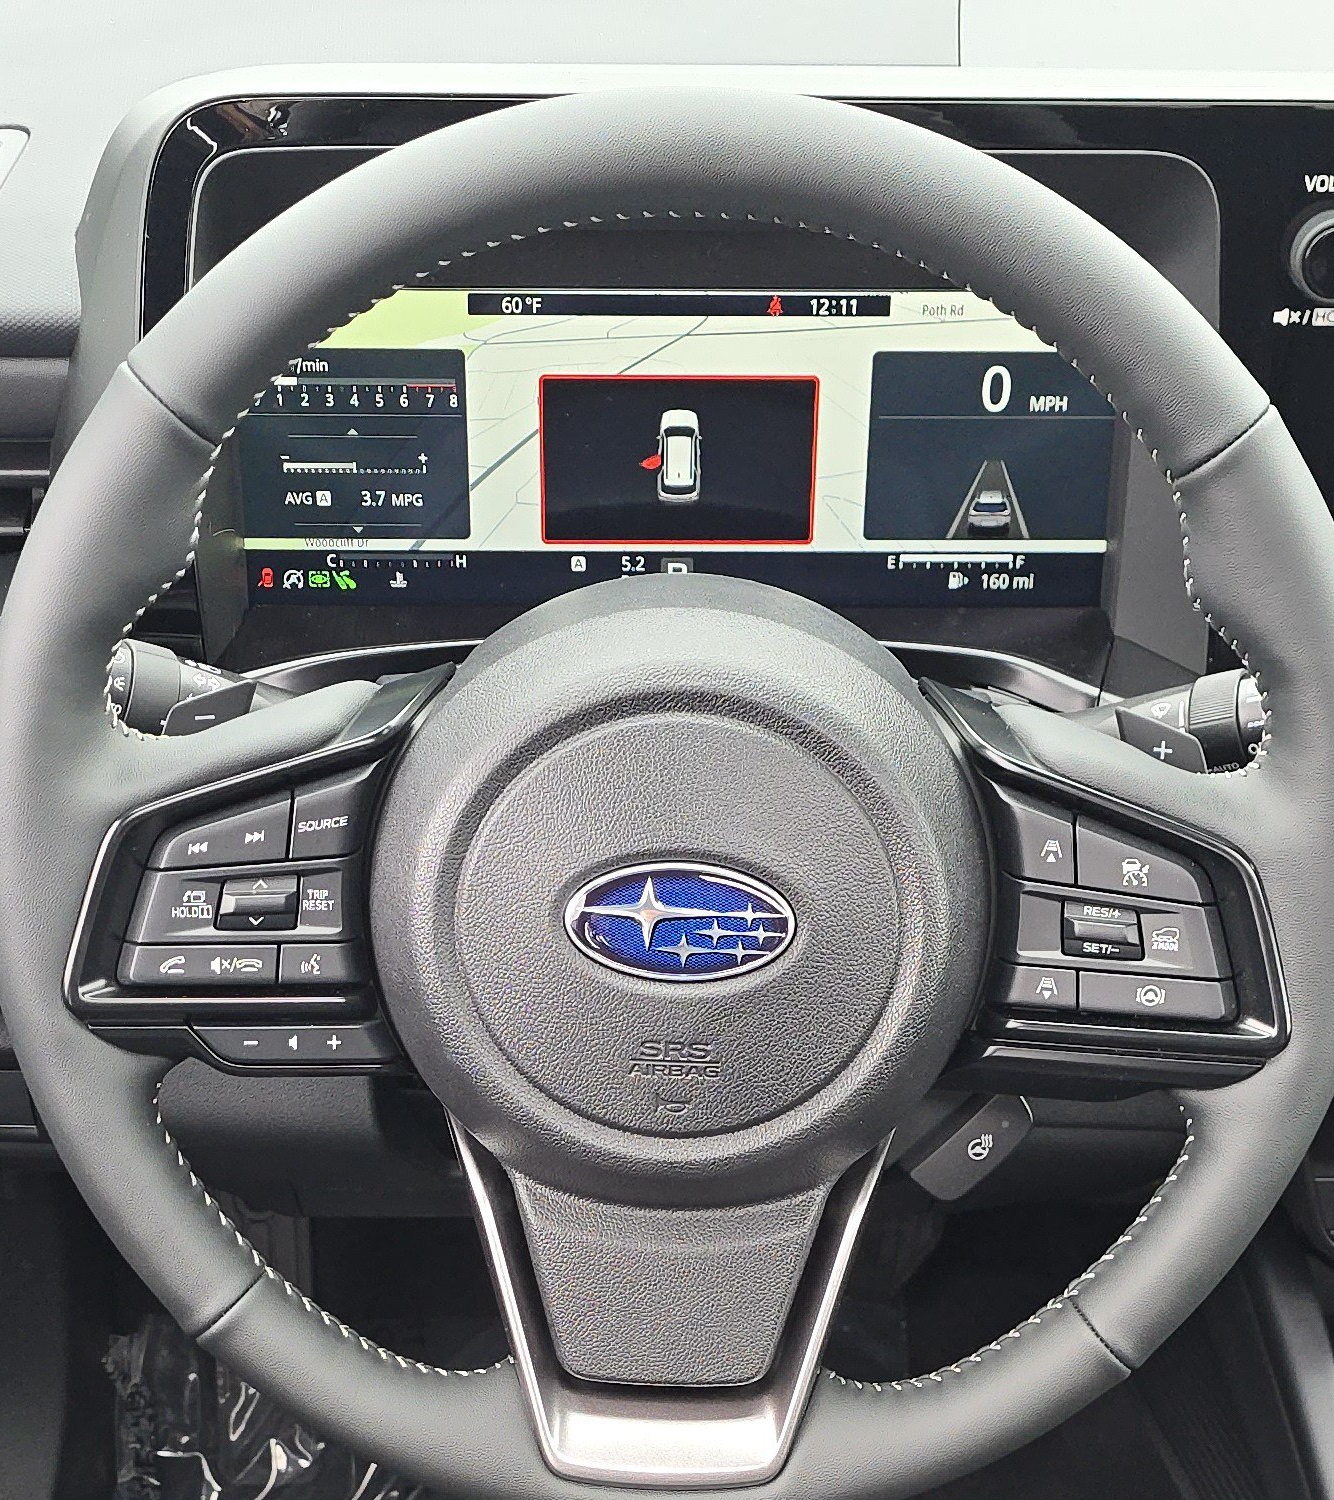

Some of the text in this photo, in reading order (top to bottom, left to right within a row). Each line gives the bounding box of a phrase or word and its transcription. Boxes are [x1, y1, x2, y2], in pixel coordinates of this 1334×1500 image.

[810, 298, 858, 315] 12:11
[922, 304, 965, 316] Poth Rd
[981, 365, 1068, 413] 0 MPH
[276, 393, 283, 406] 1
[300, 393, 310, 407] 2
[325, 393, 335, 407] 3
[349, 393, 359, 407] 4
[375, 393, 384, 407] 5
[399, 393, 409, 407] 6
[425, 394, 435, 407] 7
[449, 394, 458, 408] 8
[285, 492, 313, 505] AVG
[361, 491, 386, 506] 3.7
[391, 494, 423, 507] MPG
[327, 554, 467, 568] C H
[622, 556, 646, 572] 5.2
[887, 555, 1026, 570] E F
[981, 573, 1009, 590] 160
[297, 816, 349, 833] SOURCE
[307, 889, 329, 900] TRIP
[171, 906, 199, 918] HOLD
[303, 899, 334, 911] RESET
[639, 1041, 716, 1061] SRS
[628, 1063, 721, 1078] AIRBAG
